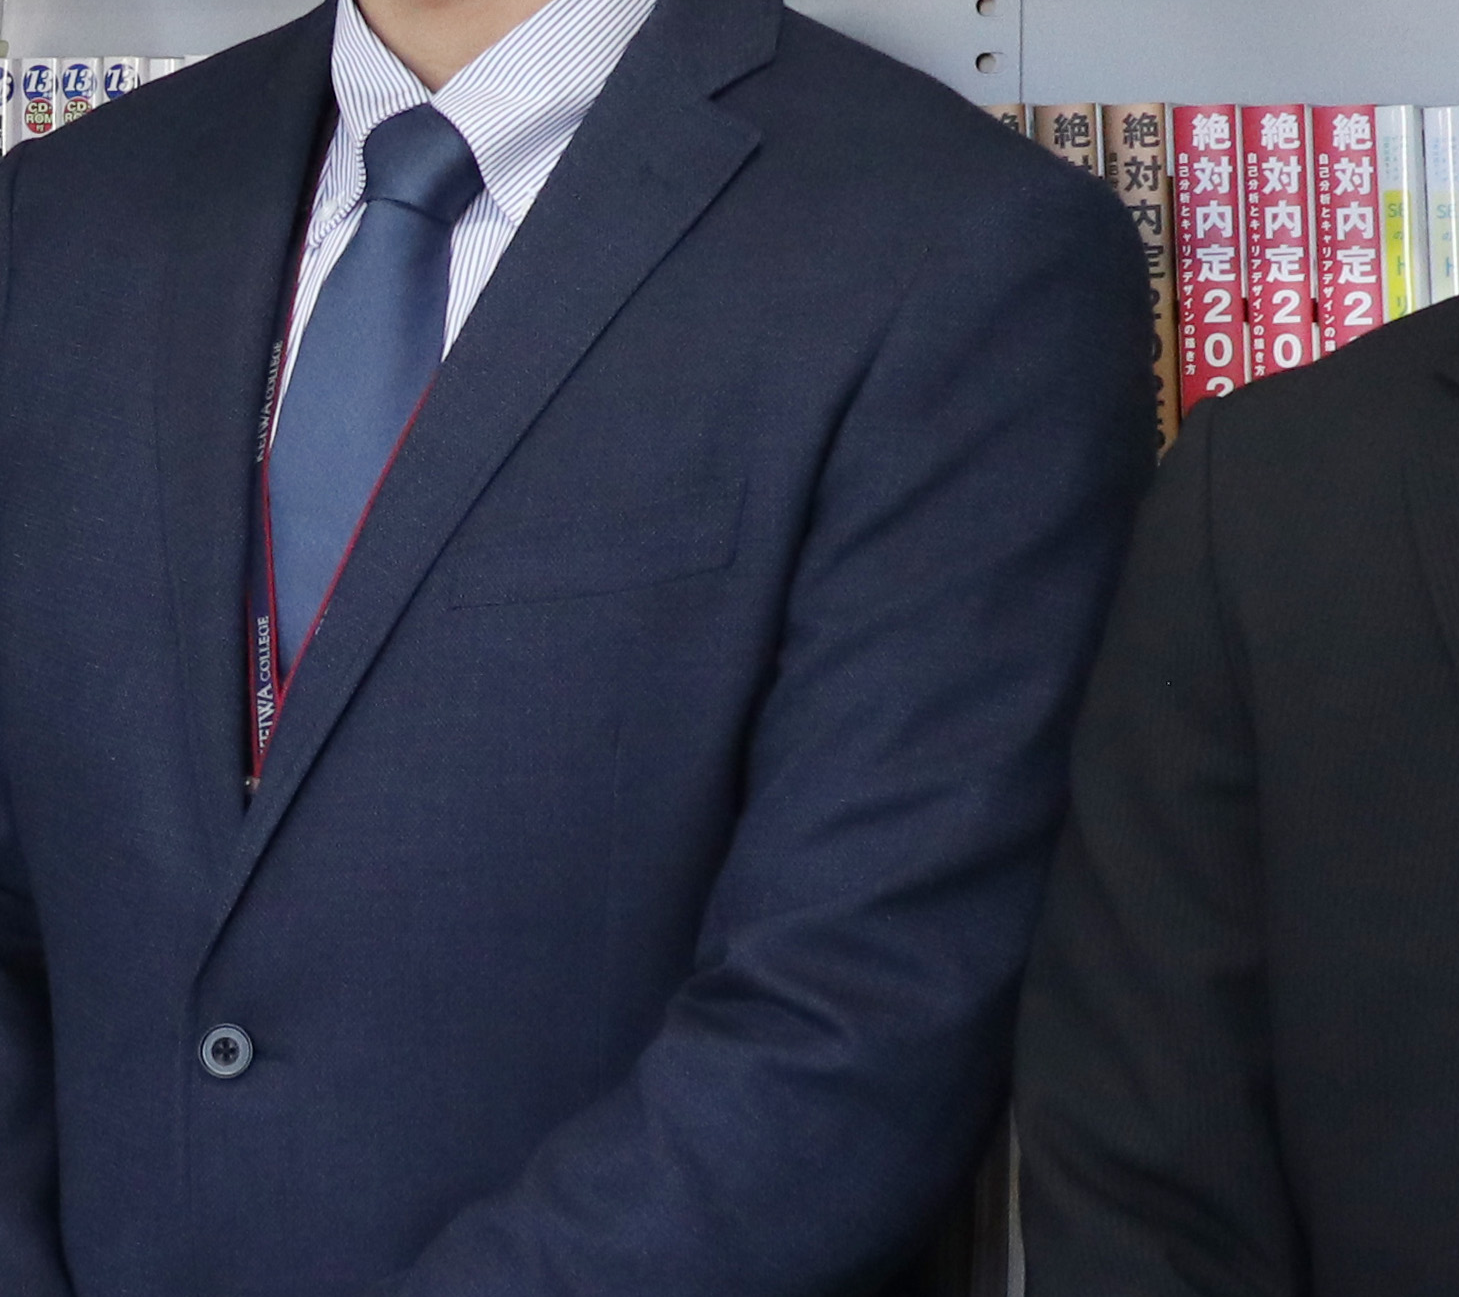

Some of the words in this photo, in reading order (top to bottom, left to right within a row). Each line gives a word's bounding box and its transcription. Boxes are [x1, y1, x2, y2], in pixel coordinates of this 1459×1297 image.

[24, 113, 55, 125] ROM
[1179, 152, 1197, 377] 自己分析とキャリアデザインの描き方
[1247, 152, 1266, 377] 自己分析とキャリアデザインの描き方
[259, 614, 271, 683] COLLEGE
